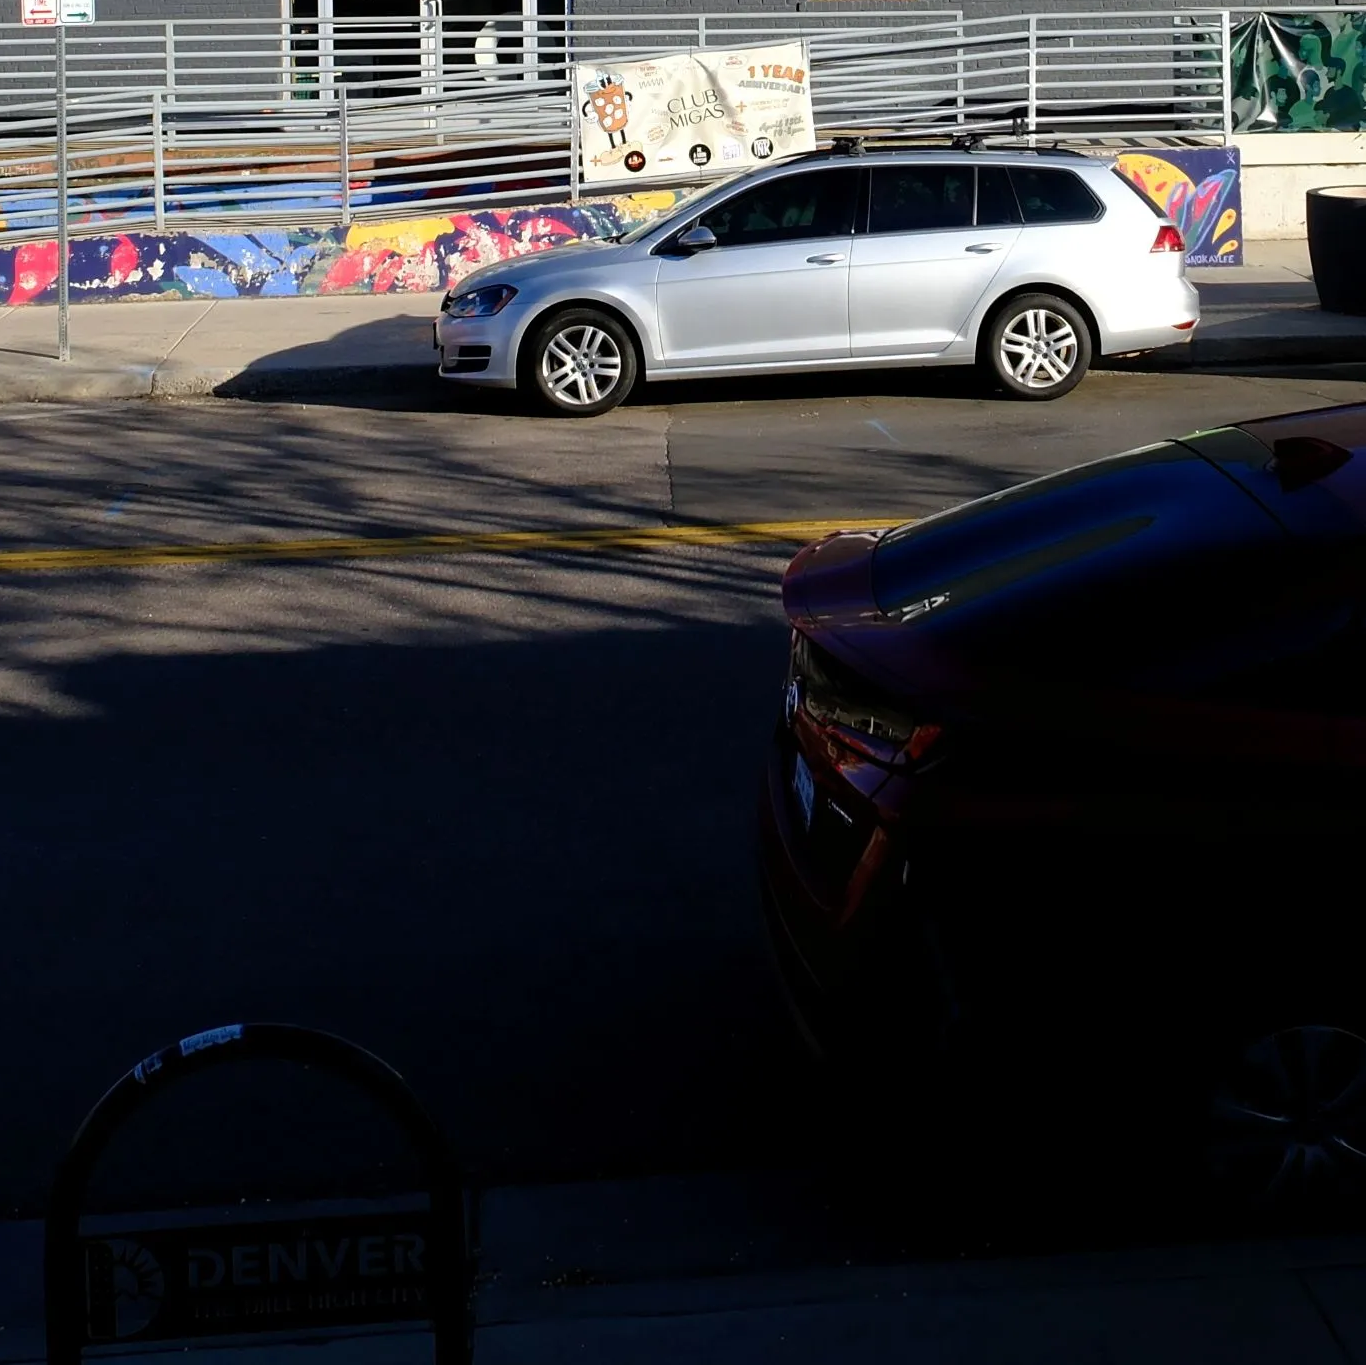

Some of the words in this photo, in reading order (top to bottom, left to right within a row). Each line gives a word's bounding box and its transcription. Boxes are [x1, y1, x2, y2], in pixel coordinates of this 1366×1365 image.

[747, 65, 756, 79] 1
[761, 64, 805, 84] YEAR
[738, 79, 808, 95] ANNIVERSARY
[667, 89, 718, 114] CLUB
[670, 103, 725, 130] MIGAS
[187, 1232, 428, 1292] DENVER
